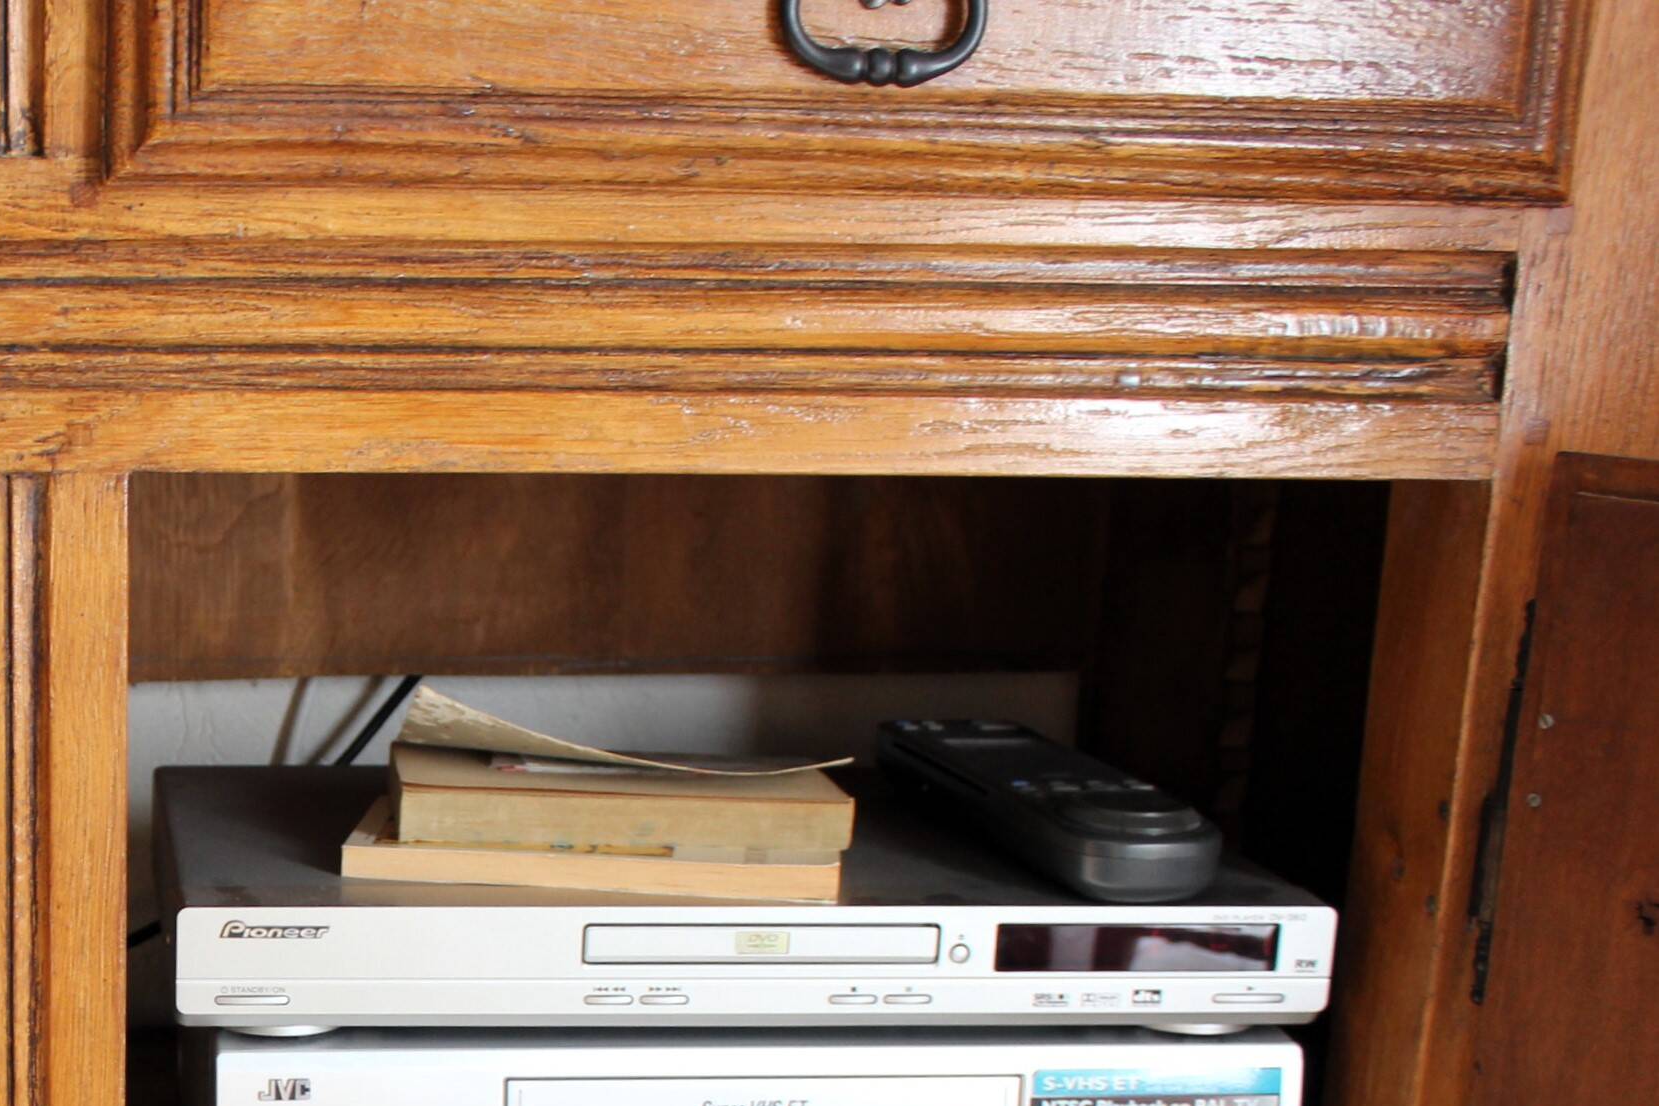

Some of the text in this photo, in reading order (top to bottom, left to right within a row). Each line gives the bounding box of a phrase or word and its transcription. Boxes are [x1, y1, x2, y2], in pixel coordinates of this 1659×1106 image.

[220, 920, 330, 939] Pioneer
[258, 1078, 311, 1101] JVC
[1042, 1075, 1141, 1092] S-VHS ET
